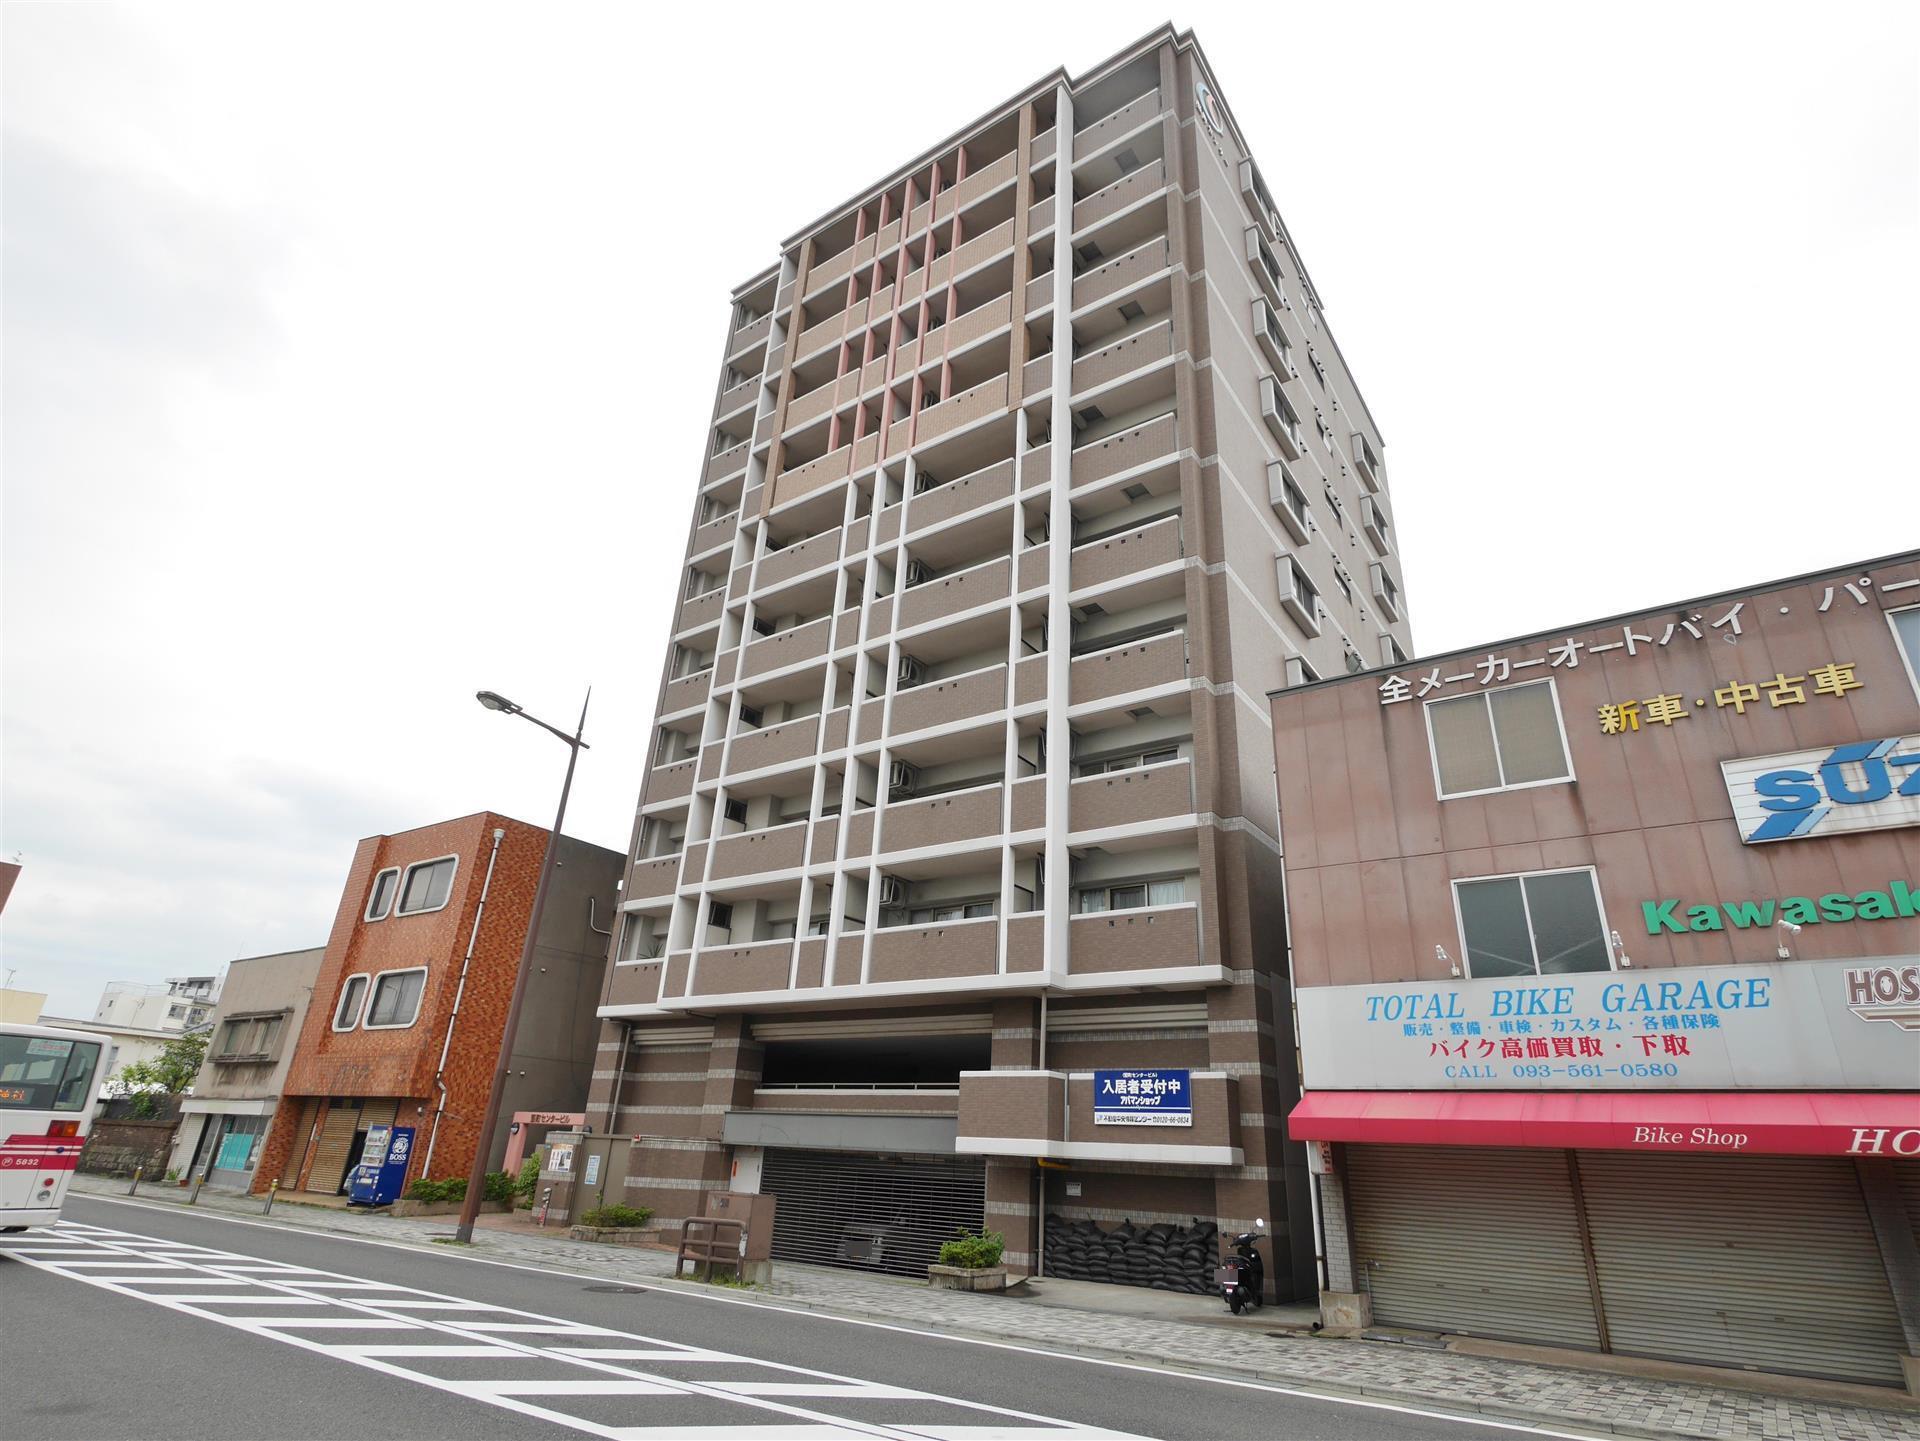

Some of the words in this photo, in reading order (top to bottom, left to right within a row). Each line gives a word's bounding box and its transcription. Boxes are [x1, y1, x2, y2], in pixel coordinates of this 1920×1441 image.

[1598, 662, 1865, 735] 新車・中古車
[1366, 992, 1465, 1021] TOTAL
[1490, 987, 1574, 1017] BIKE
[1602, 978, 1771, 1013] GARAGE
[1403, 1013, 1721, 1037] 販売・整備・車検・カスタム・各種保険
[1429, 1034, 1691, 1059] バイク高価買取・下取
[1445, 1064, 1497, 1078] CALL
[1512, 1063, 1678, 1078] 093-561-0580
[1102, 1079, 1181, 1095] 入居者受付中
[1120, 1095, 1162, 1105] アパマンショップ
[1632, 1126, 1683, 1144] Bike
[1690, 1127, 1748, 1148] Shop
[389, 1153, 407, 1161] BOSS
